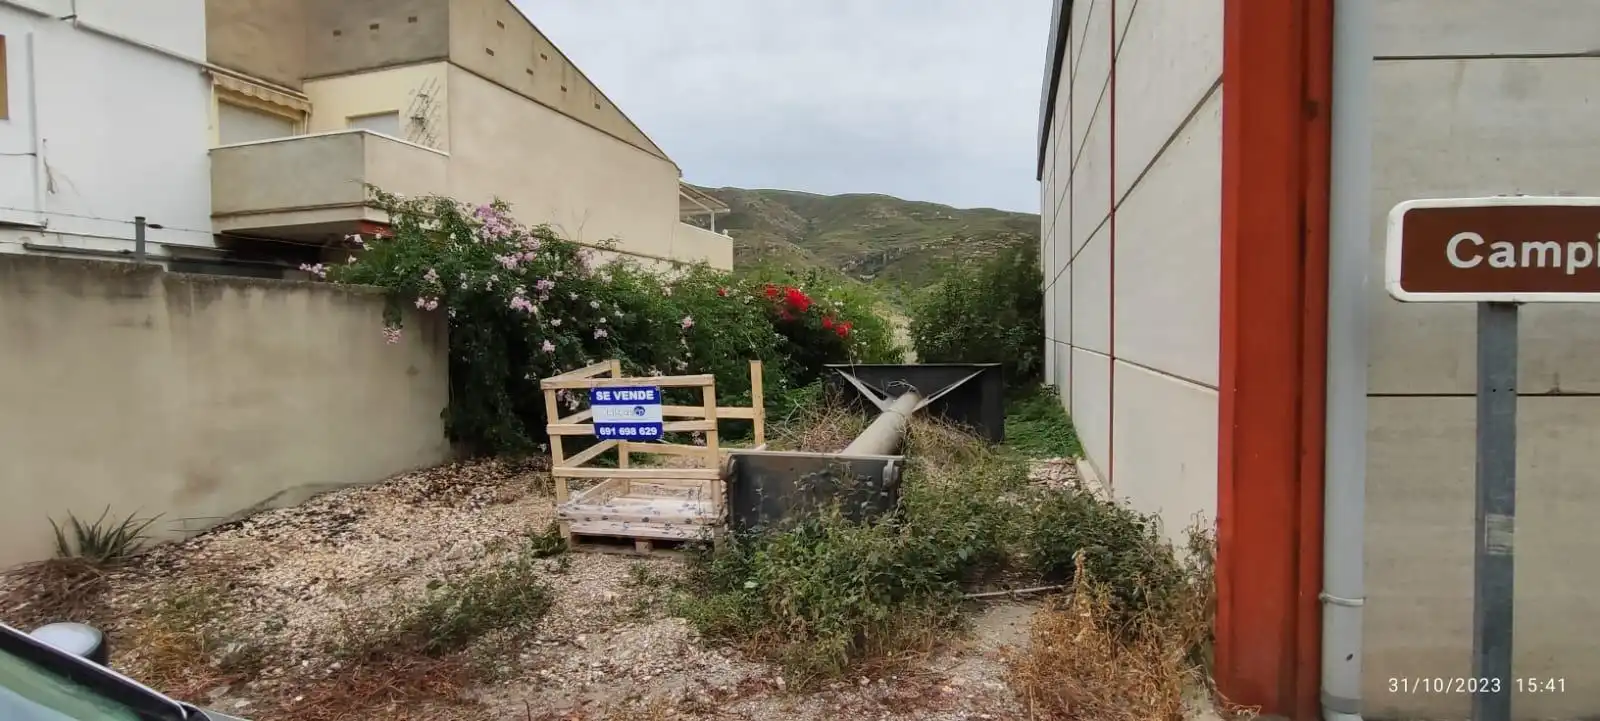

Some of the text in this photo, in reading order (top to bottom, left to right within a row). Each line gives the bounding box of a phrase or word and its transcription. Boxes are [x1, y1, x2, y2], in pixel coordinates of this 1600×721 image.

[596, 390, 654, 401] SE VENDE
[599, 427, 616, 436] 691
[638, 427, 658, 436] 629
